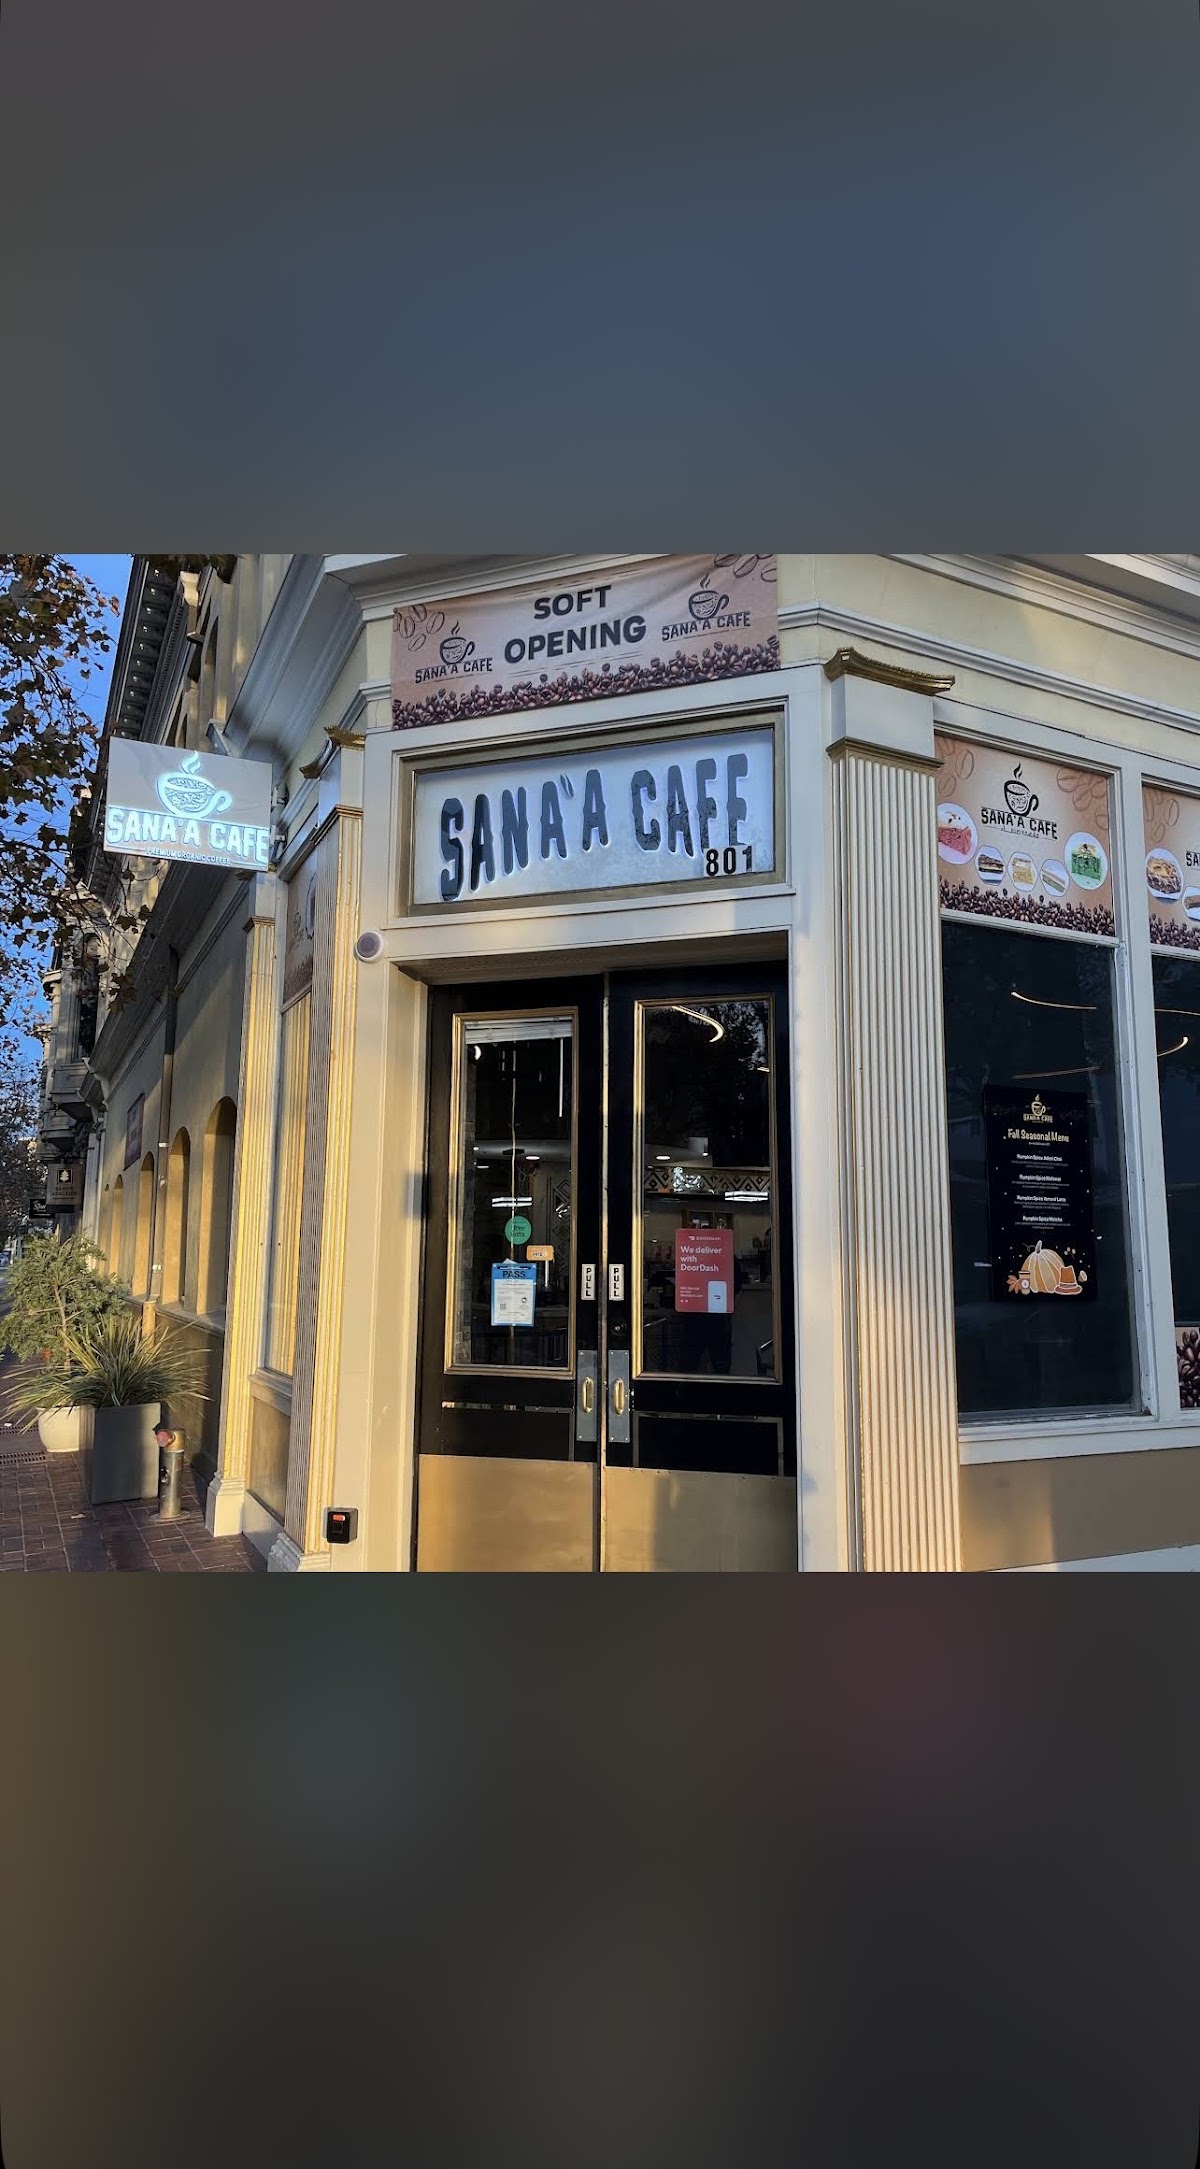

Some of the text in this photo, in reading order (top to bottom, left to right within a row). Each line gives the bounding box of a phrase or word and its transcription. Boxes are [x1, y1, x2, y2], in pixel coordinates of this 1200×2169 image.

[534, 585, 612, 620] SOFT
[504, 615, 647, 664] OPENING
[662, 619, 712, 642] SANA'A
[716, 612, 751, 629] CAFE
[415, 664, 459, 684] SANA'A
[463, 657, 493, 673] CAFE
[630, 753, 749, 858] CAFE
[106, 807, 270, 864] SANA'A CAFE
[981, 808, 1025, 829] SANA'A
[1029, 818, 1058, 840] CAFE
[146, 847, 231, 865] PREMIUM ORGANIC COFFEE
[705, 845, 753, 877] 801
[1007, 1128, 1070, 1143] Fall Seasonal Menu
[680, 1245, 722, 1254] We deliver
[680, 1255, 698, 1263] with
[502, 1270, 526, 1279] PASS
[680, 1263, 720, 1272] DoorDash
